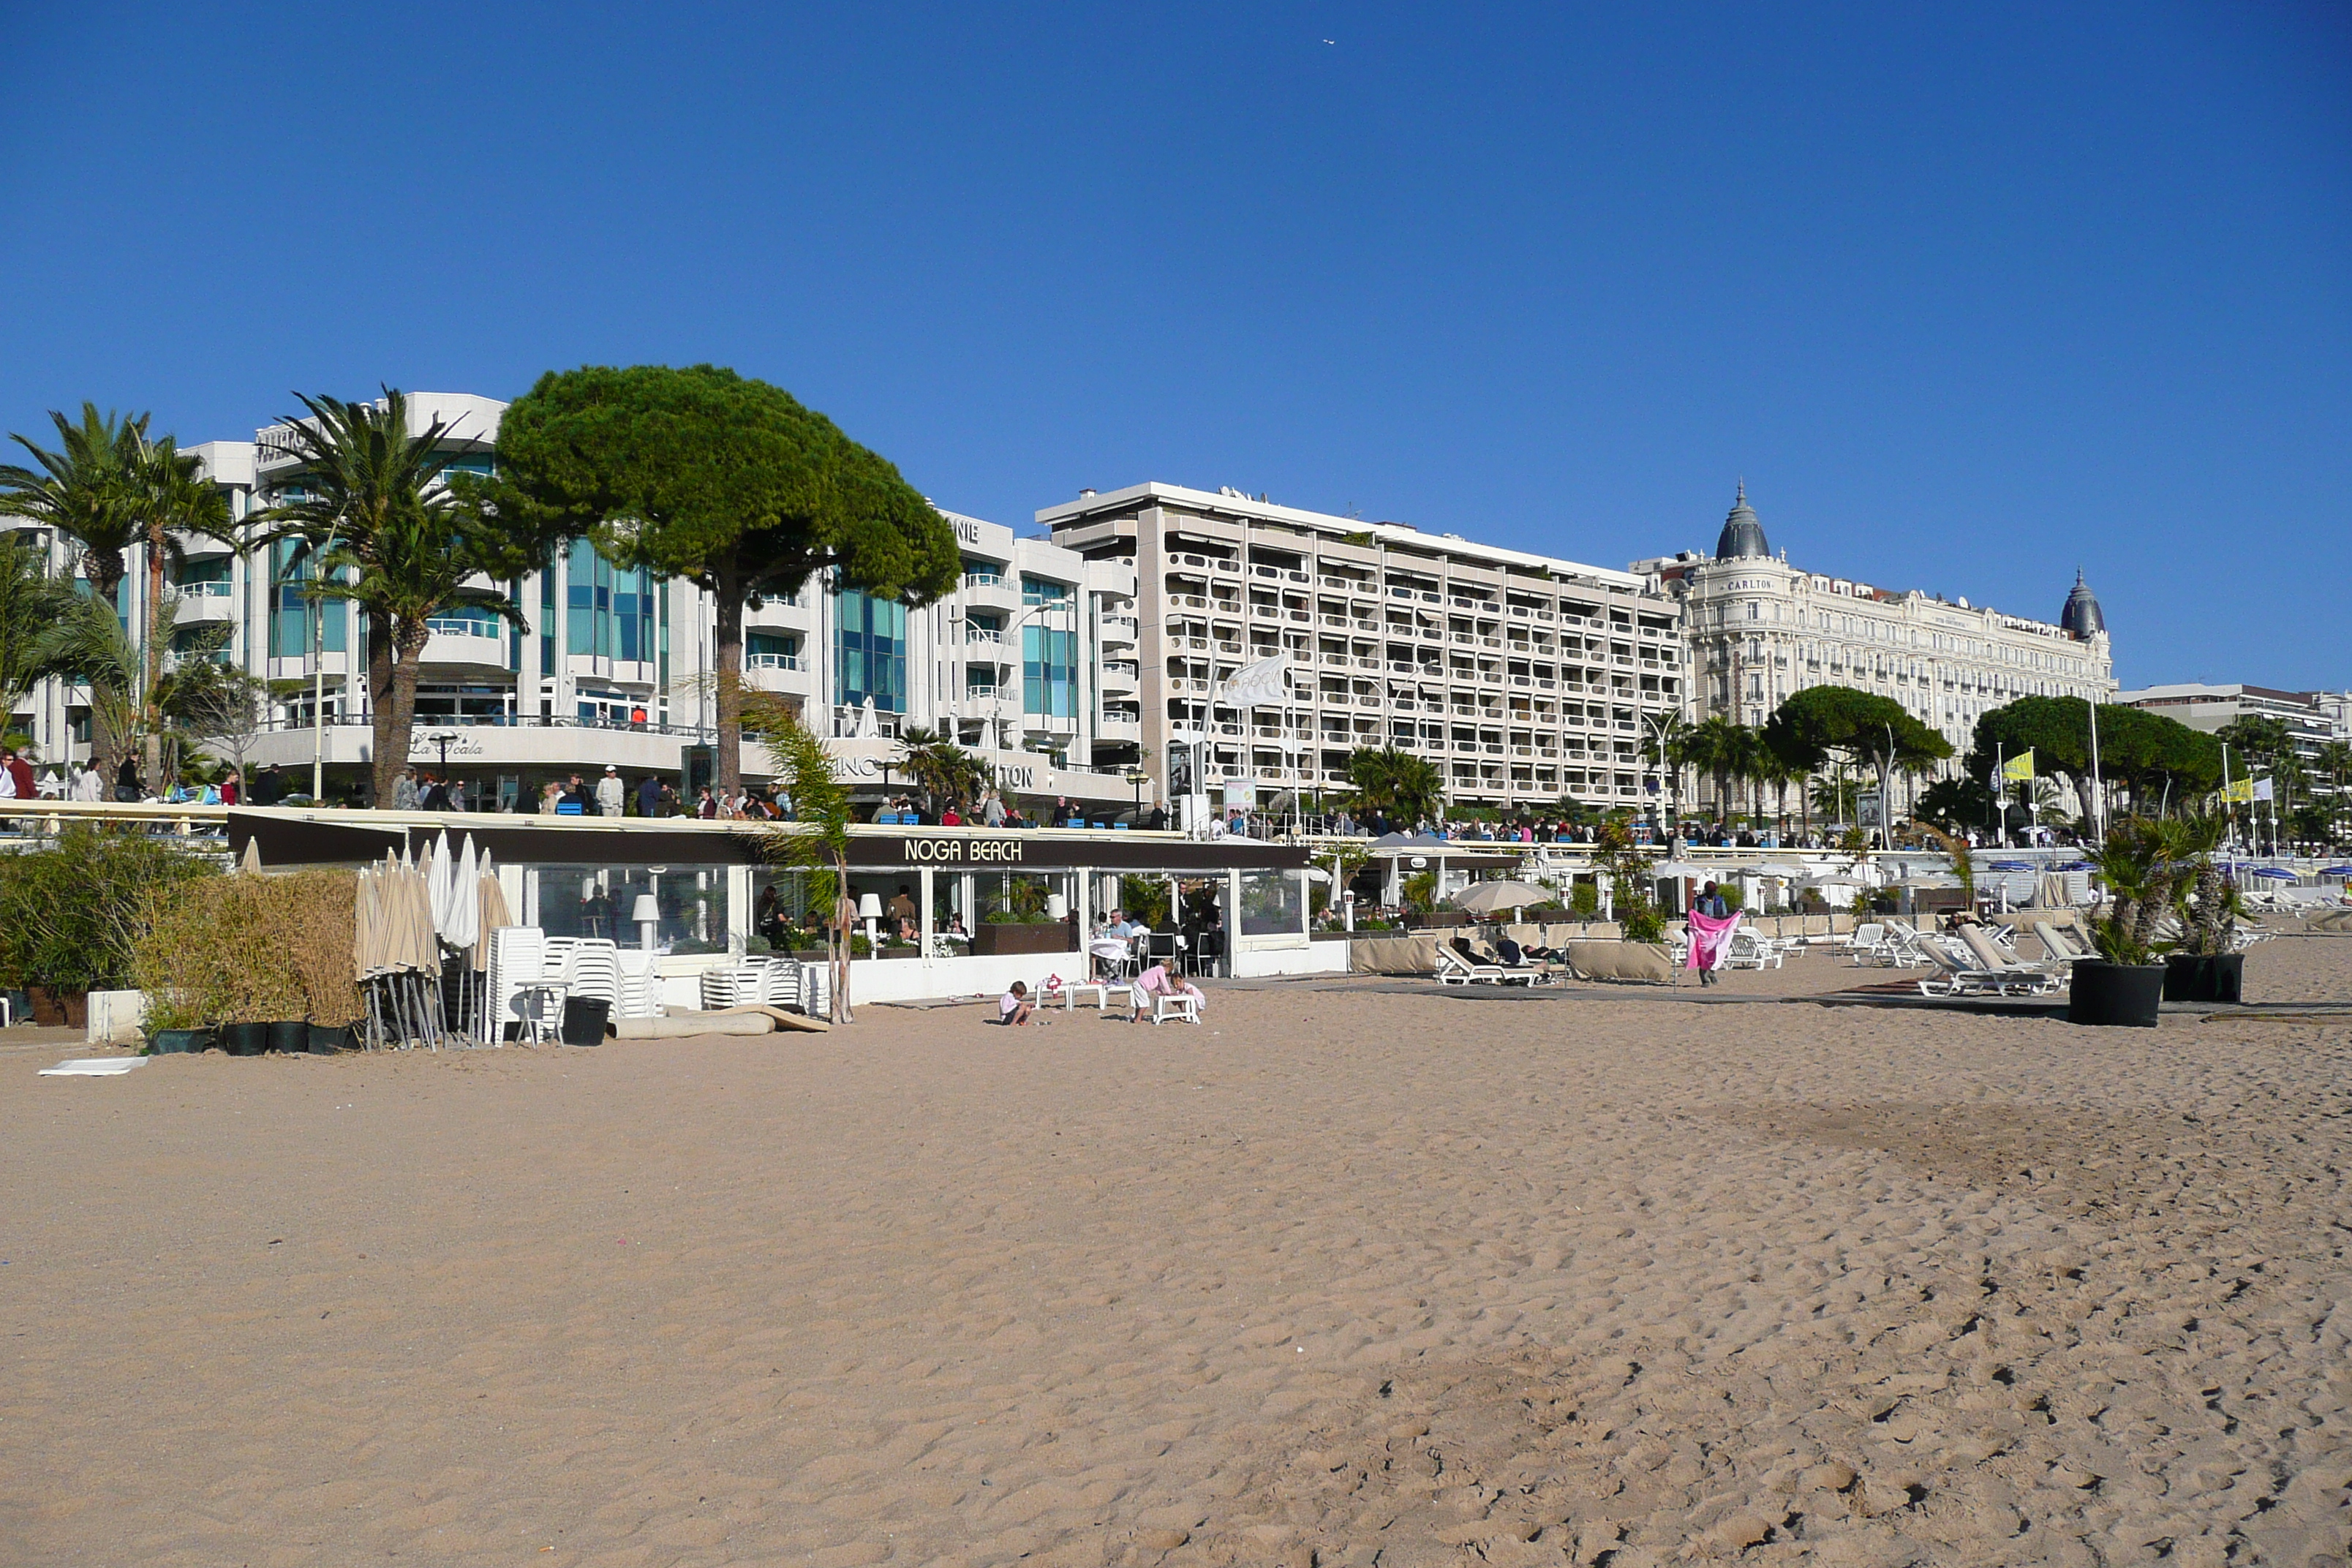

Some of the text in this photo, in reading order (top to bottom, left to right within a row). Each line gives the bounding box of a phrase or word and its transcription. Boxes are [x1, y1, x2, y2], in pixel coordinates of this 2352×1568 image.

[1727, 580, 1771, 590] CARLTON
[905, 840, 1022, 861] NOGA BEACH
